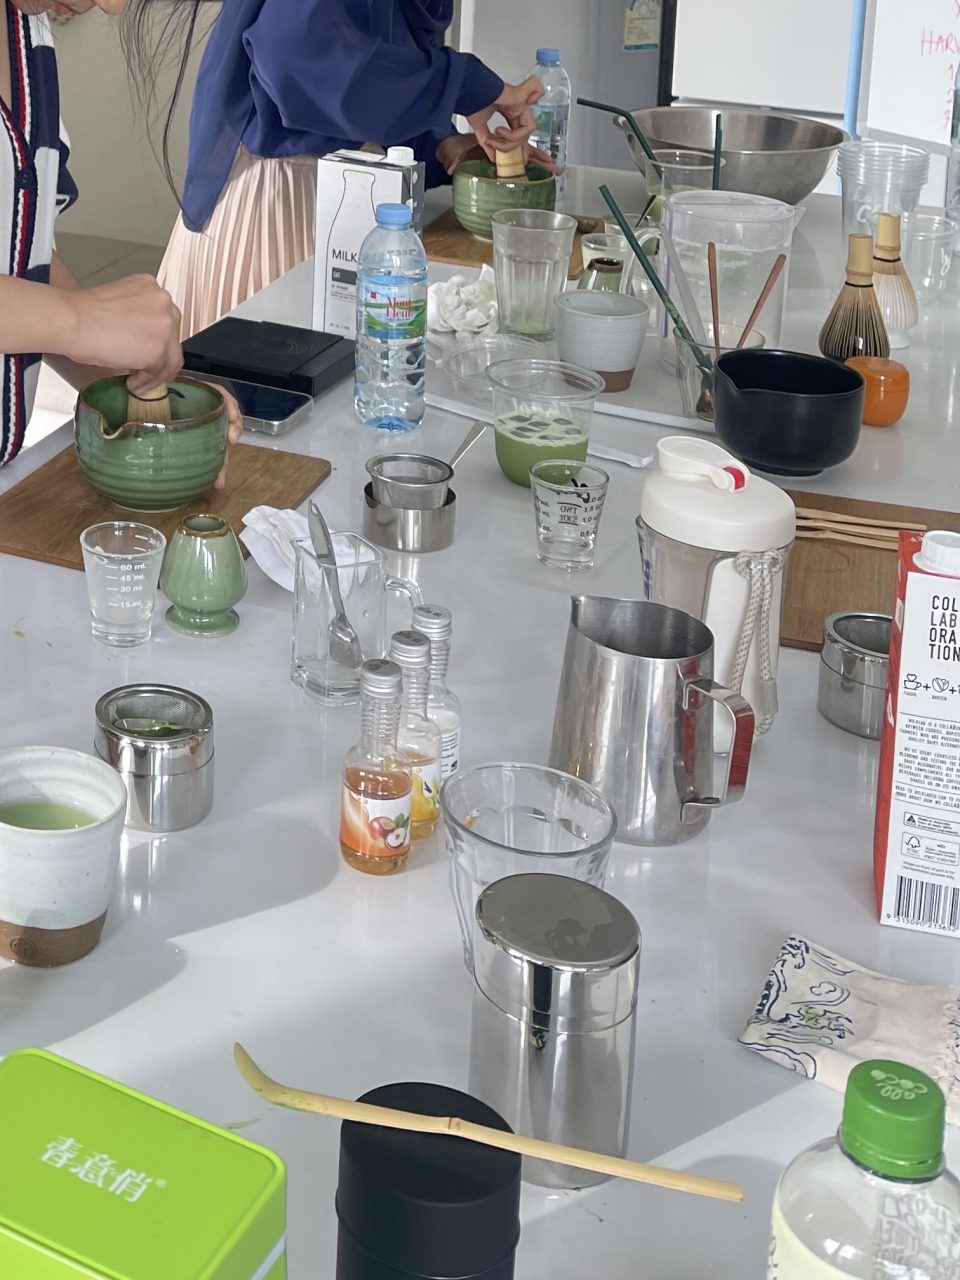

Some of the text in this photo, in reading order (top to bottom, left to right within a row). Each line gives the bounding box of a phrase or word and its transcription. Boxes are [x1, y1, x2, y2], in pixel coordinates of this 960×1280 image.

[932, 595, 958, 612] COL
[930, 611, 957, 628] LAB
[929, 628, 957, 644] ORA
[929, 644, 960, 662] TION
[41, 1136, 153, 1202] 春意俏
